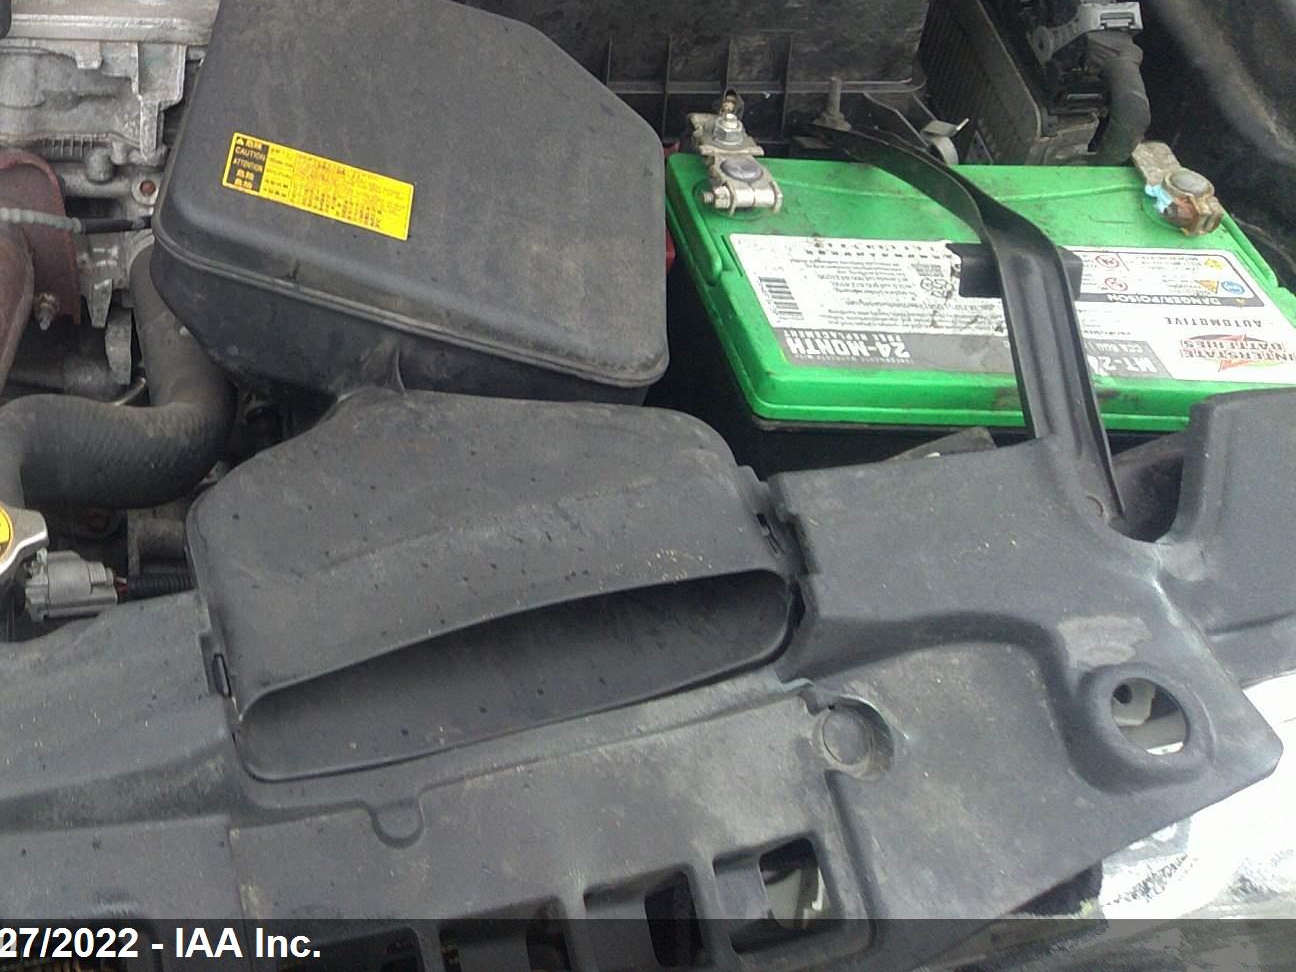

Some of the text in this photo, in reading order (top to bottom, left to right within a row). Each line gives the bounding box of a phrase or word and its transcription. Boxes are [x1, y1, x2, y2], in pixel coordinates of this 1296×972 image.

[234, 146, 266, 162] CAUTION
[1106, 293, 1222, 306] DANGER/POISON
[1163, 316, 1262, 329] AUTOMOTIVE
[785, 337, 911, 358] 24-MONTH
[1181, 348, 1296, 362] INTERSTATE
